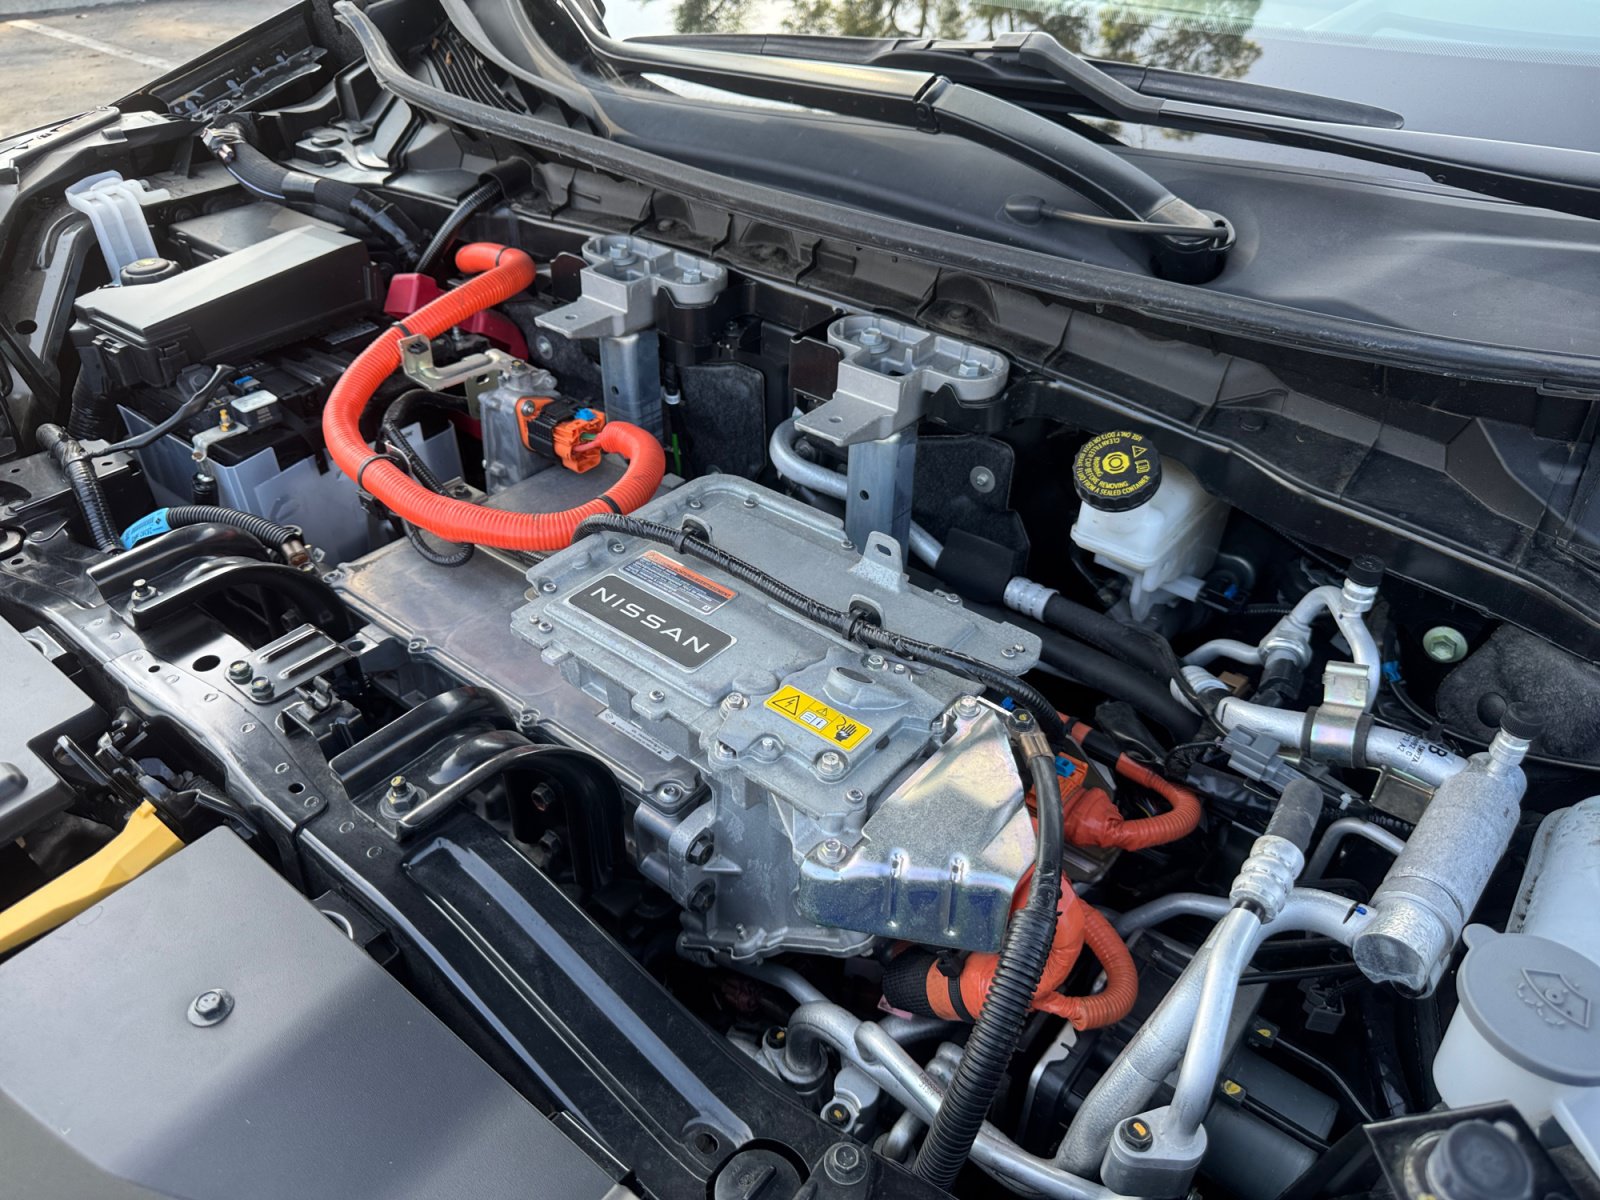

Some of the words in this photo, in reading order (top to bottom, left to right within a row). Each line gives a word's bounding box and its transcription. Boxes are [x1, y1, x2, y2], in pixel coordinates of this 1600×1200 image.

[1101, 437, 1120, 445] CLEAN
[1121, 475, 1151, 494] CONTAINER
[590, 587, 711, 654] NISSAN
[1428, 743, 1448, 757] B
